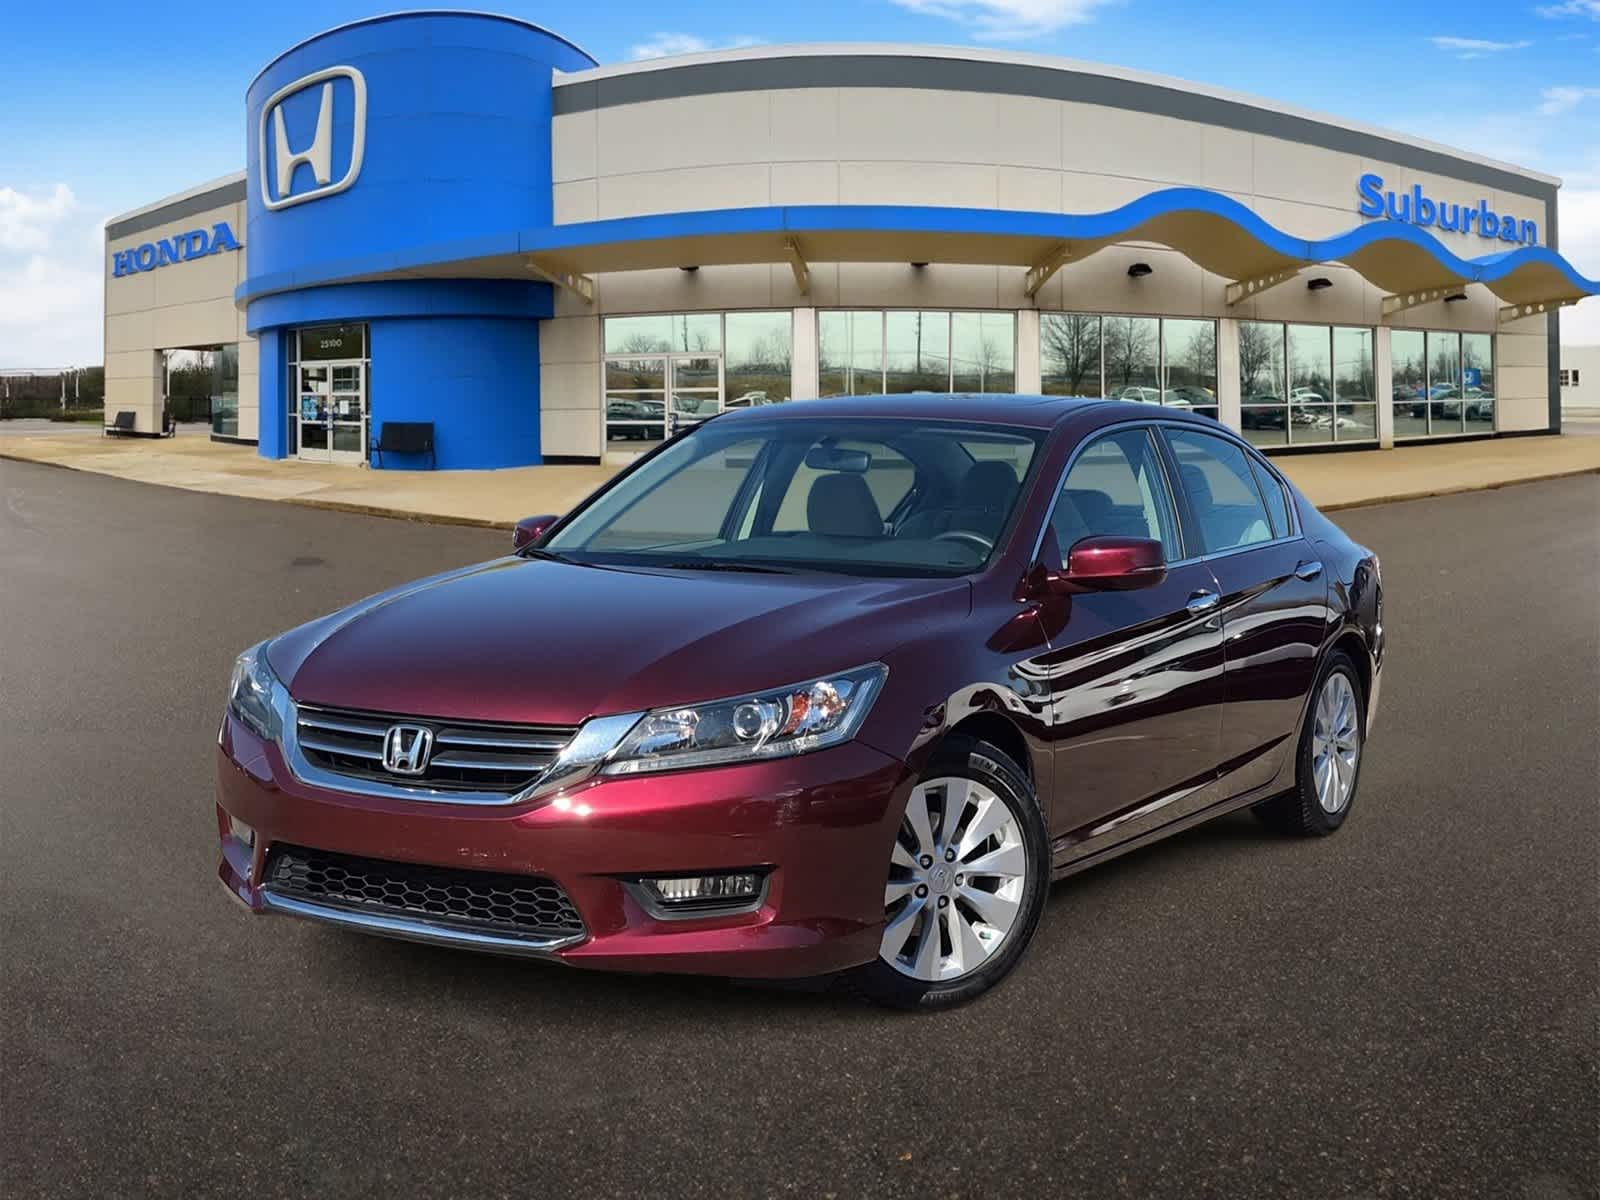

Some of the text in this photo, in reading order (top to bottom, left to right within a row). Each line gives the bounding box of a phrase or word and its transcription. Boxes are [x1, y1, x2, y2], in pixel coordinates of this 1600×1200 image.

[273, 81, 334, 197] H
[1358, 173, 1538, 245] Suburban
[112, 221, 242, 278] HONDA
